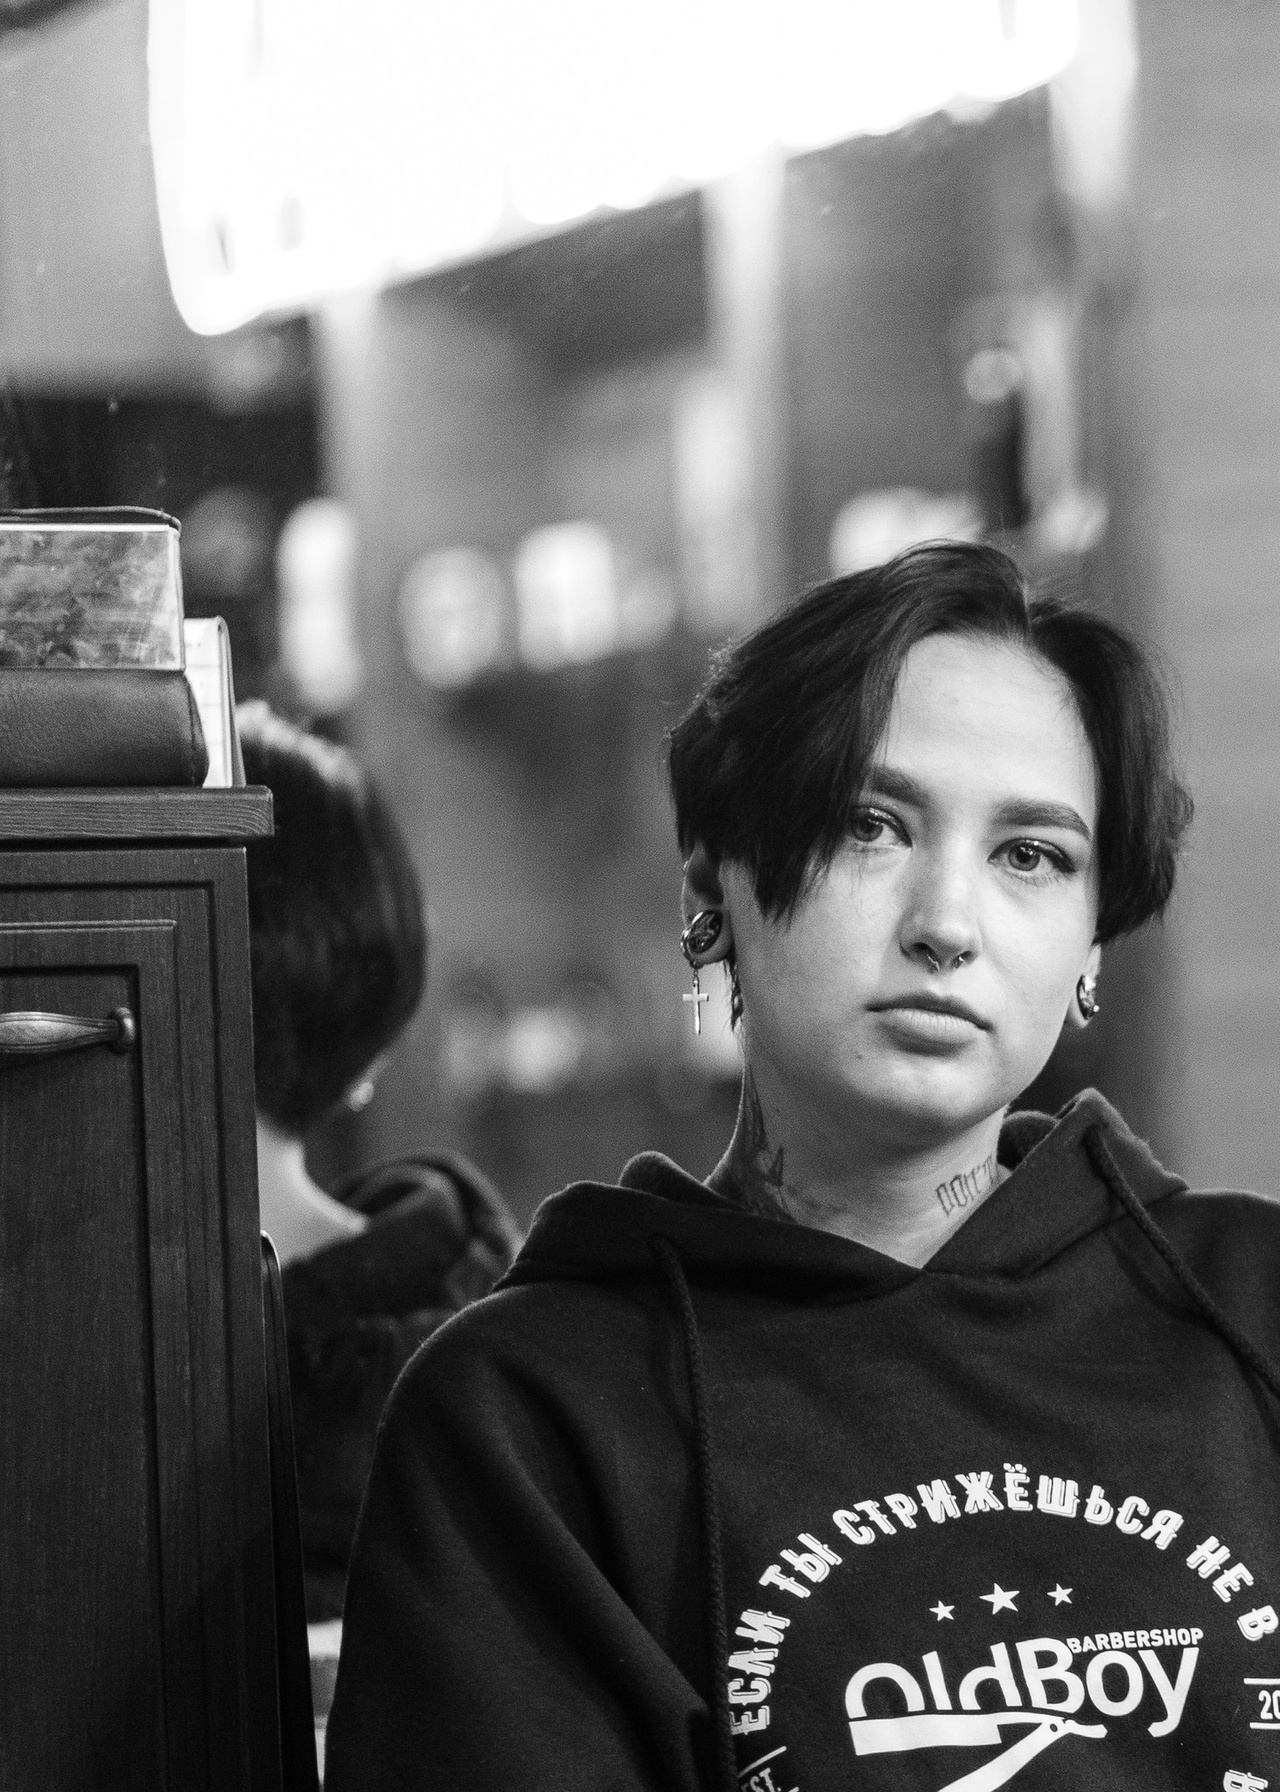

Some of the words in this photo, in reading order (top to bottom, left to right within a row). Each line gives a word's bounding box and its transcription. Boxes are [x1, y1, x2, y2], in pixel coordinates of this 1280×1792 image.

[727, 1609, 791, 1735] ЕСЛИ
[759, 1533, 842, 1598] ТЫ
[832, 1463, 1184, 1550] СТРИЖЁШЬСЯ
[1186, 1535, 1254, 1603] НЕ
[1237, 1605, 1279, 1641] В
[1066, 1628, 1203, 1654] BARBERSHOP
